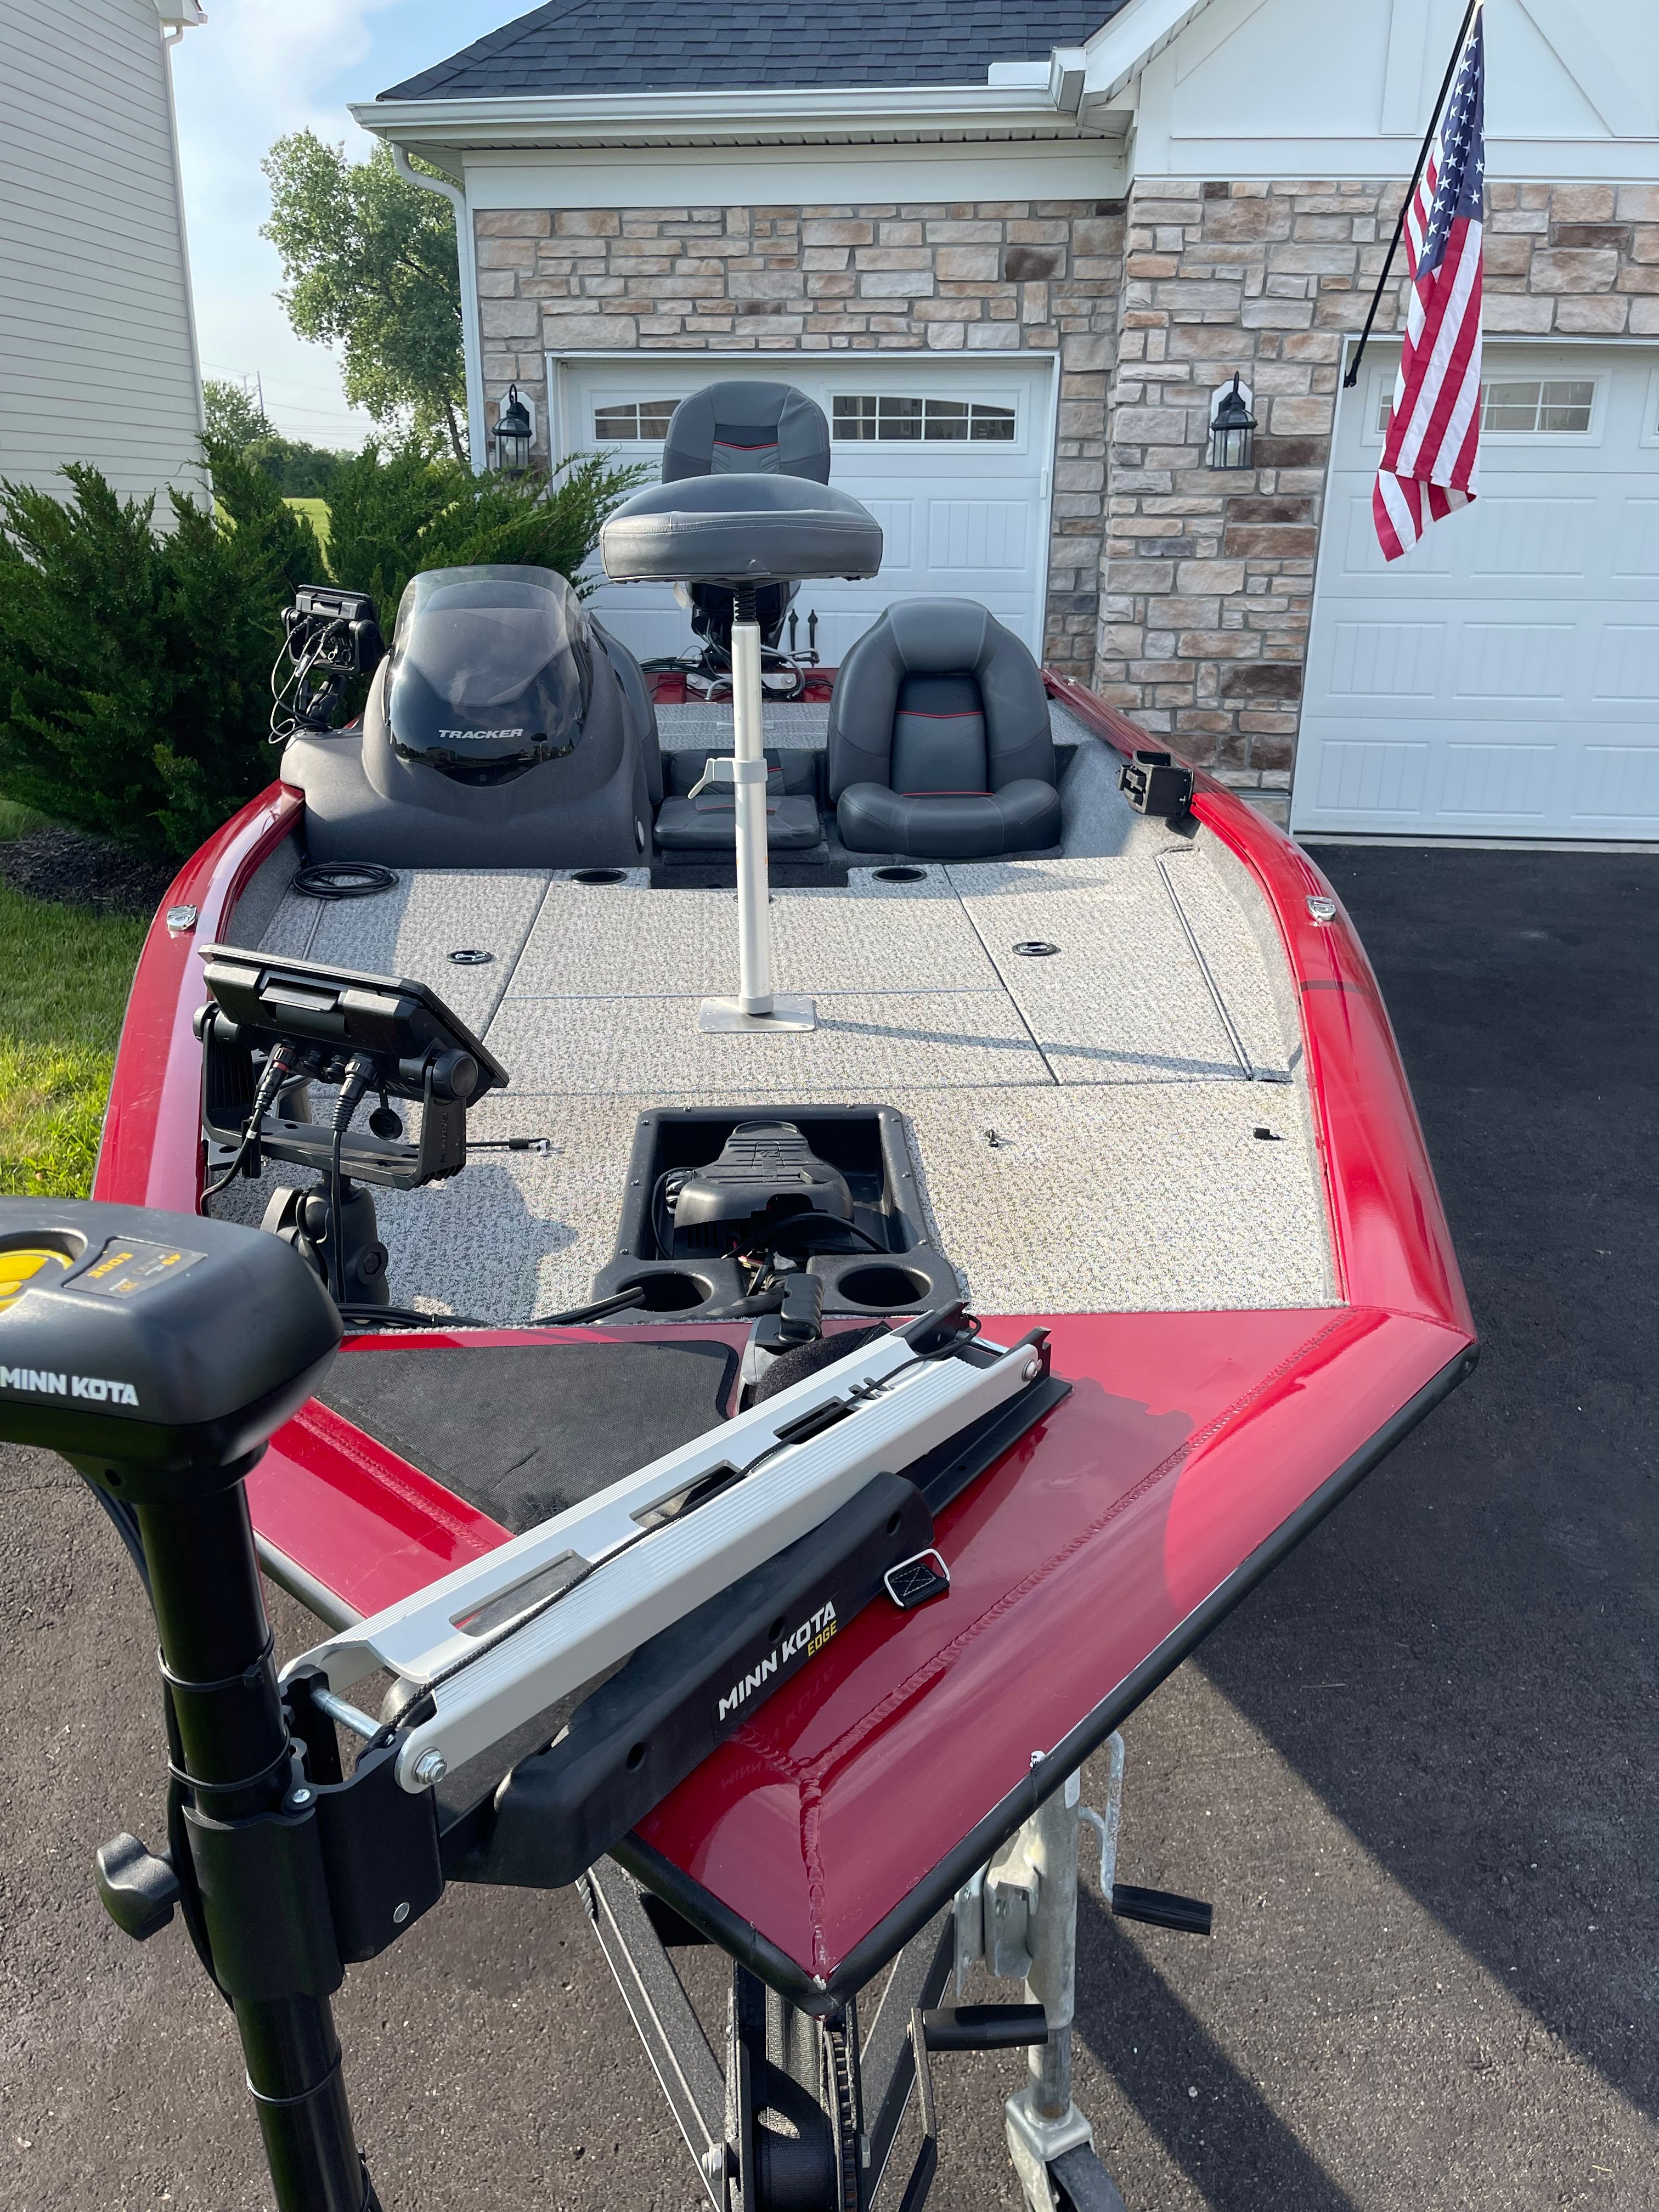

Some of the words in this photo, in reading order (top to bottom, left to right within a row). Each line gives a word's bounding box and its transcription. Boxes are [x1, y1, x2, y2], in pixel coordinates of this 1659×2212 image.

[438, 729, 524, 740] TRACKER
[87, 1252, 133, 1279] EDGE
[0, 1365, 67, 1395] MINN
[71, 1375, 140, 1406] KOTA
[808, 1620, 837, 1657] EDGE
[719, 1650, 777, 1721] MINN
[782, 1600, 836, 1663] KOTA
